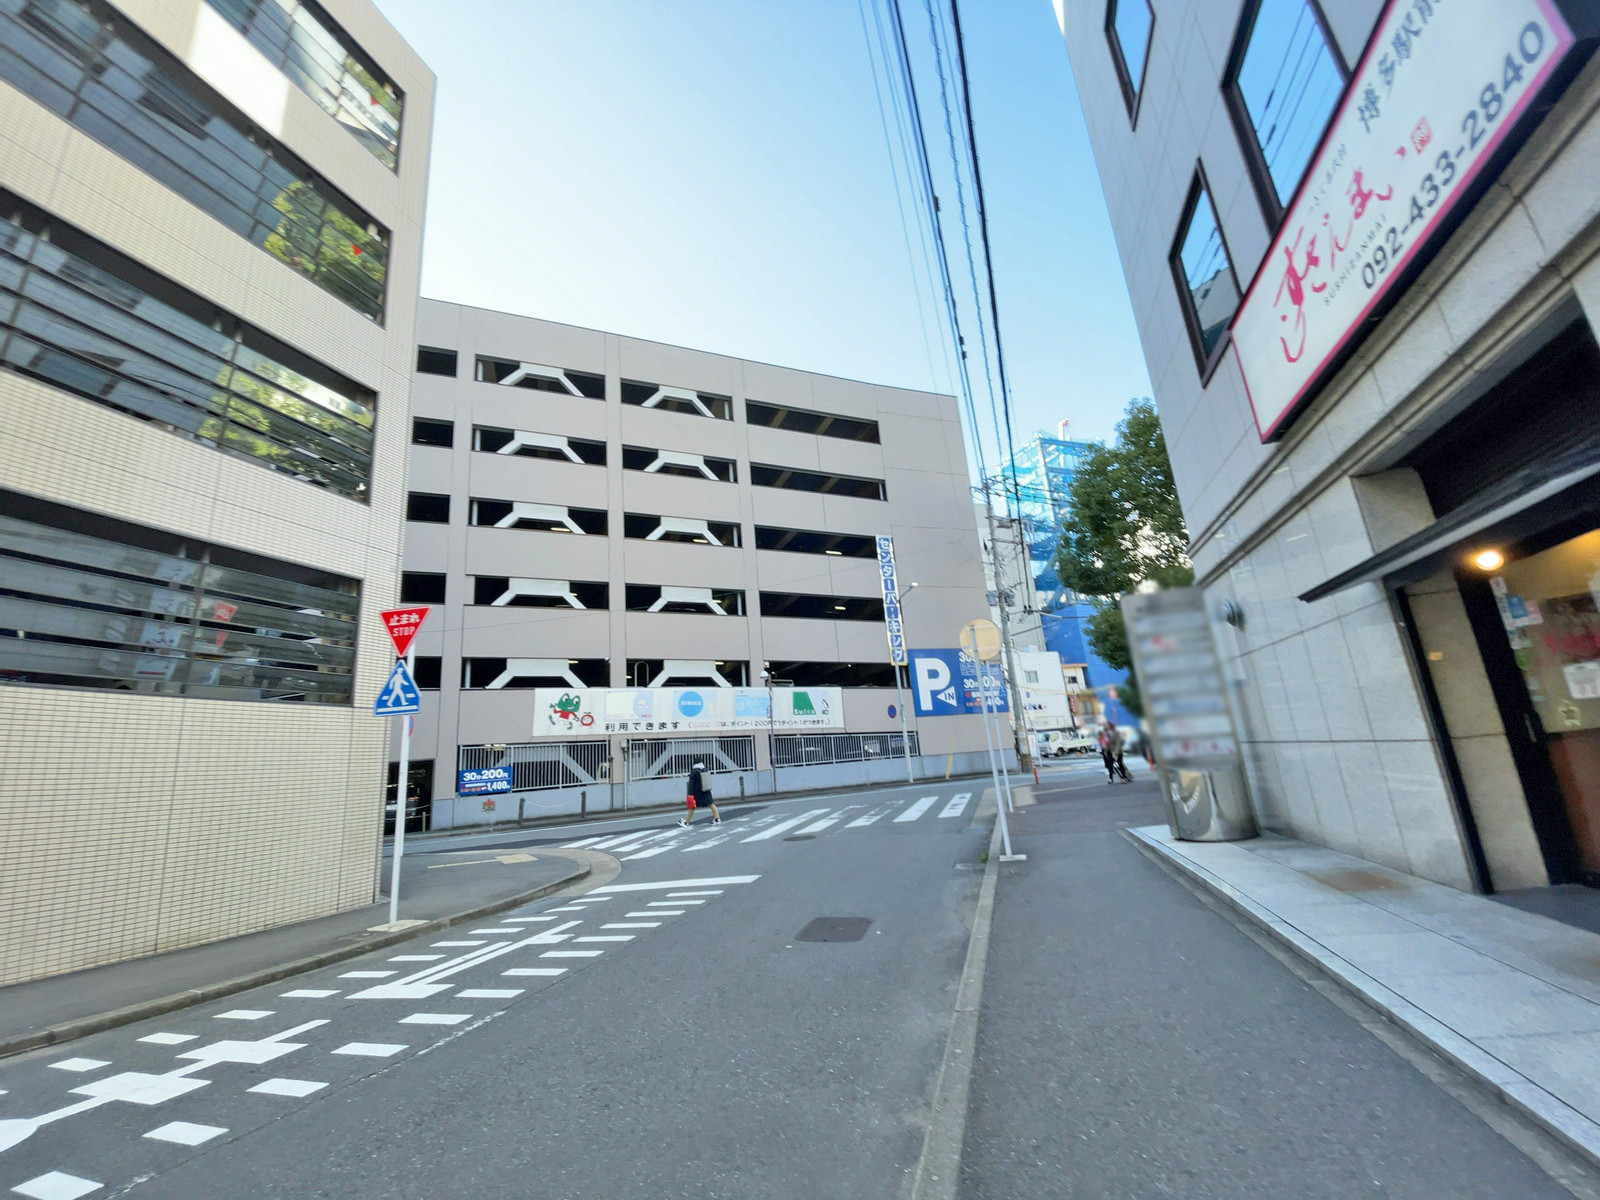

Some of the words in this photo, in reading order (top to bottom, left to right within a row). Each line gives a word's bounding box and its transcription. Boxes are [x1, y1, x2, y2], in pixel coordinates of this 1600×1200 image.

[1361, 20, 1545, 290] 092-433-2840
[388, 612, 421, 626] 止まれ
[392, 626, 416, 637] STOP
[914, 657, 951, 711] P
[944, 692, 955, 701] IN
[793, 708, 815, 716] Suica
[605, 721, 680, 732] 利用できます
